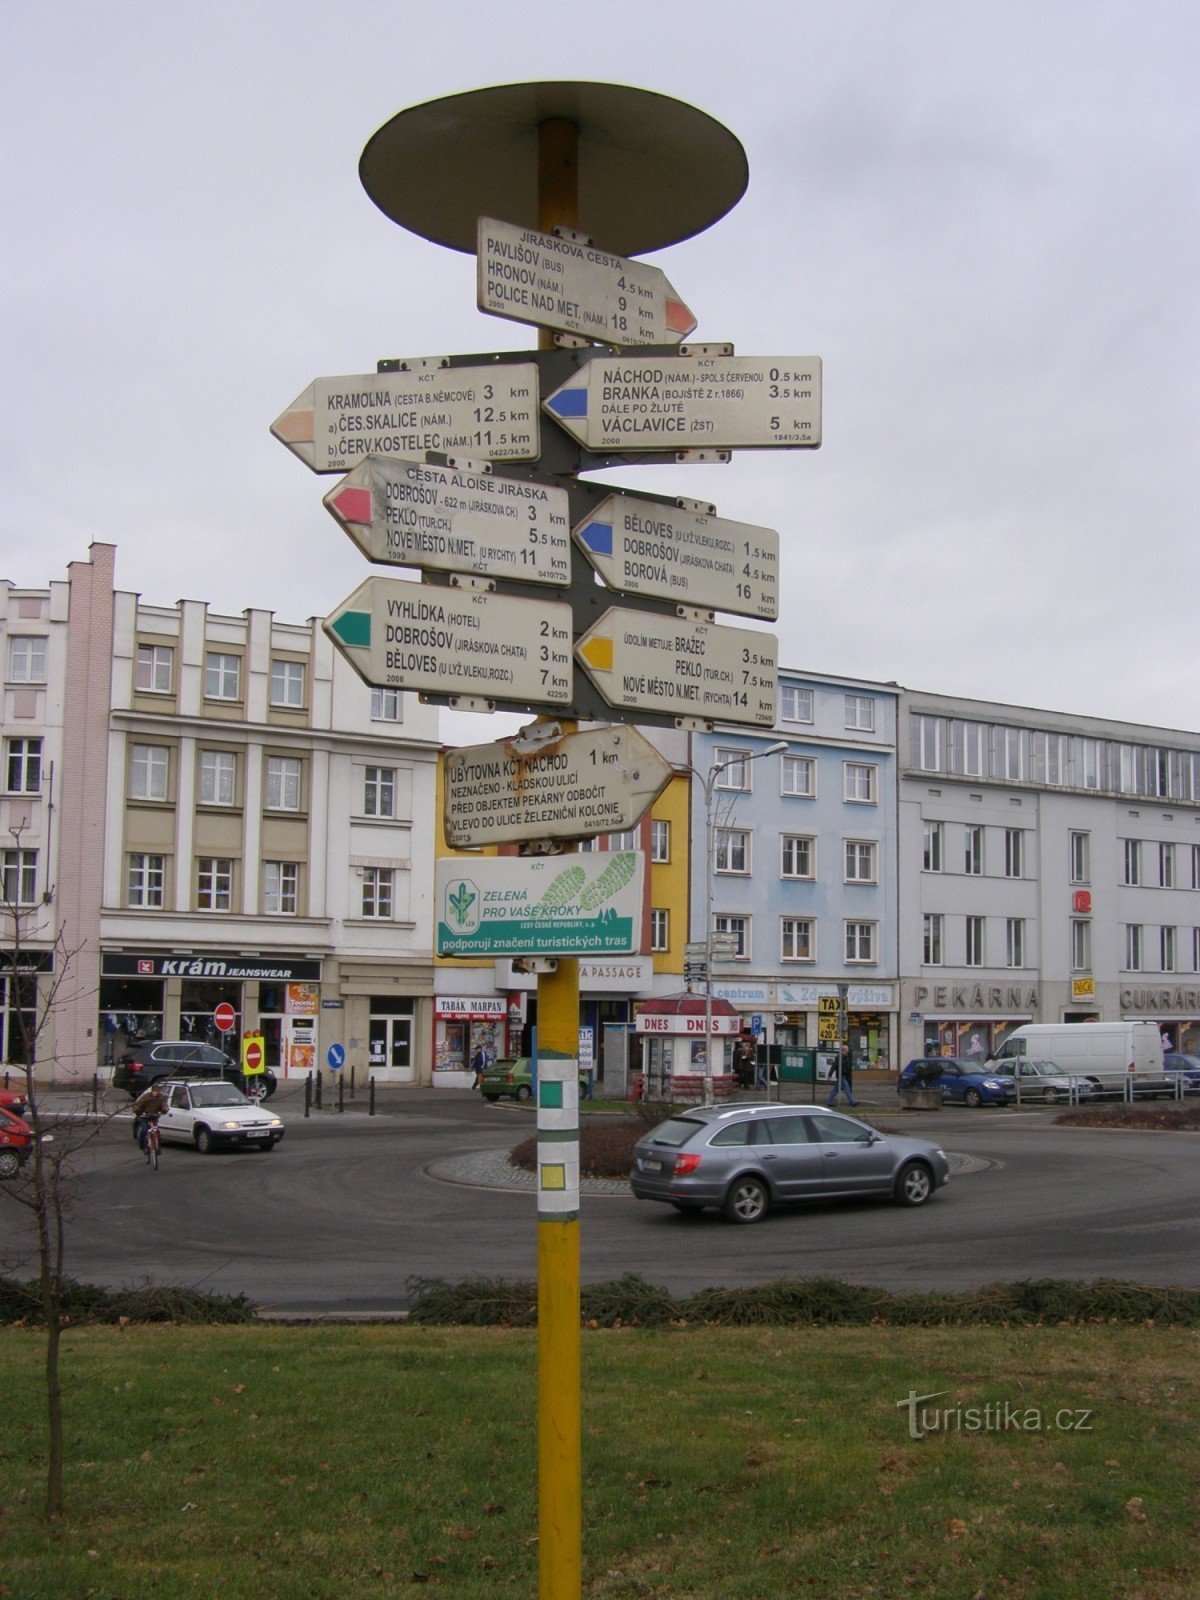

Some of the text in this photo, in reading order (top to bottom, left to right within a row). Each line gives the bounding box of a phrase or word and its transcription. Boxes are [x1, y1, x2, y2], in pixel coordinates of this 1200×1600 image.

[520, 231, 623, 271] JIRÁSKOVA CESTA
[487, 239, 653, 299] PAVLIŠOV (BUS) 4.5 km
[487, 260, 653, 319] HRONOV (NÁM.) 9 km
[487, 281, 654, 340] POLICE NAD MET. (NÁM.) 18 km
[488, 300, 504, 310] 2000
[419, 374, 435, 383] KČT
[604, 367, 811, 384] NÁCHOD (NÁM.) ČERVENOU 0.5 km
[328, 384, 529, 410] KRAMOLNA 3 km
[603, 387, 659, 400] BRANKA
[707, 390, 713, 398] Z
[769, 385, 790, 398] 3.5
[794, 389, 811, 398] km
[602, 401, 683, 414] DÁLE PO ŽLUTÉ
[328, 407, 529, 434] a) ČES.SKALICE (NÁM.) 12.5 km
[602, 416, 811, 432] VÁCLAVICE (ŽST) 5 km
[328, 444, 337, 456] b)
[339, 433, 440, 455] ČERV.KOSTELEC
[443, 434, 472, 449] (NÁM.)
[512, 434, 529, 444] km
[602, 437, 620, 445] 2000
[328, 459, 345, 468] 2000
[407, 468, 547, 501] CESTA ALOISE JIRÁSKA
[387, 483, 565, 525] DOBROŠOV 622 3 km
[387, 507, 566, 547] PEKLO 5.5 km
[696, 517, 707, 525] KČT
[387, 529, 567, 569] NOVÉ MĚSTO 11 km
[388, 551, 405, 560] 1999
[744, 541, 759, 557] 1.5
[762, 550, 775, 561] km
[624, 538, 775, 583] DOBROŠOV 4.5 km
[624, 580, 638, 589] 2000
[625, 561, 775, 604] BOROVÁ (BUS) 16 km
[472, 595, 487, 604] KČT
[388, 599, 568, 639] VYHLÍDKA (HOTEL) 2 km
[695, 626, 707, 635] KČT
[386, 625, 568, 663] DOBROŠOV 3 km
[675, 636, 773, 667] BRAŽEC 3.5 km
[387, 675, 403, 683] 2000
[540, 669, 548, 685] 7
[552, 676, 568, 687] km
[676, 660, 773, 689] PEKLO 7.5 km
[623, 674, 645, 693] NOVÉ
[647, 676, 674, 697] MĚSTO
[733, 692, 747, 706] 14
[759, 700, 772, 711] km
[623, 695, 637, 703] 2000
[451, 749, 618, 783] UBYTOVNA KČT NÁCHOD 1 km
[451, 770, 578, 799] NEZNAČENO KLADSKOU ULICÍ
[451, 786, 605, 815] PŘED OBJEKTEM PEKÁRNY ODBOČIT
[452, 802, 619, 831] VLEVO DO ULICE ŽELEZNIČNÍ KOLONIE
[484, 888, 527, 901] ZELENÁ
[483, 905, 583, 918] PRO VAŠE KROKY
[443, 936, 627, 950] podporují značení turistických tras
[227, 969, 291, 978] JEANSWEAR
[592, 967, 641, 978] PASSAGE
[441, 999, 502, 1011] TABÁK MARPAN
[822, 999, 846, 1010] TAX
[915, 983, 1039, 1008] PEKÁRNA
[1120, 986, 1200, 1010] CUKRÁR
[644, 1019, 669, 1030] DNES
